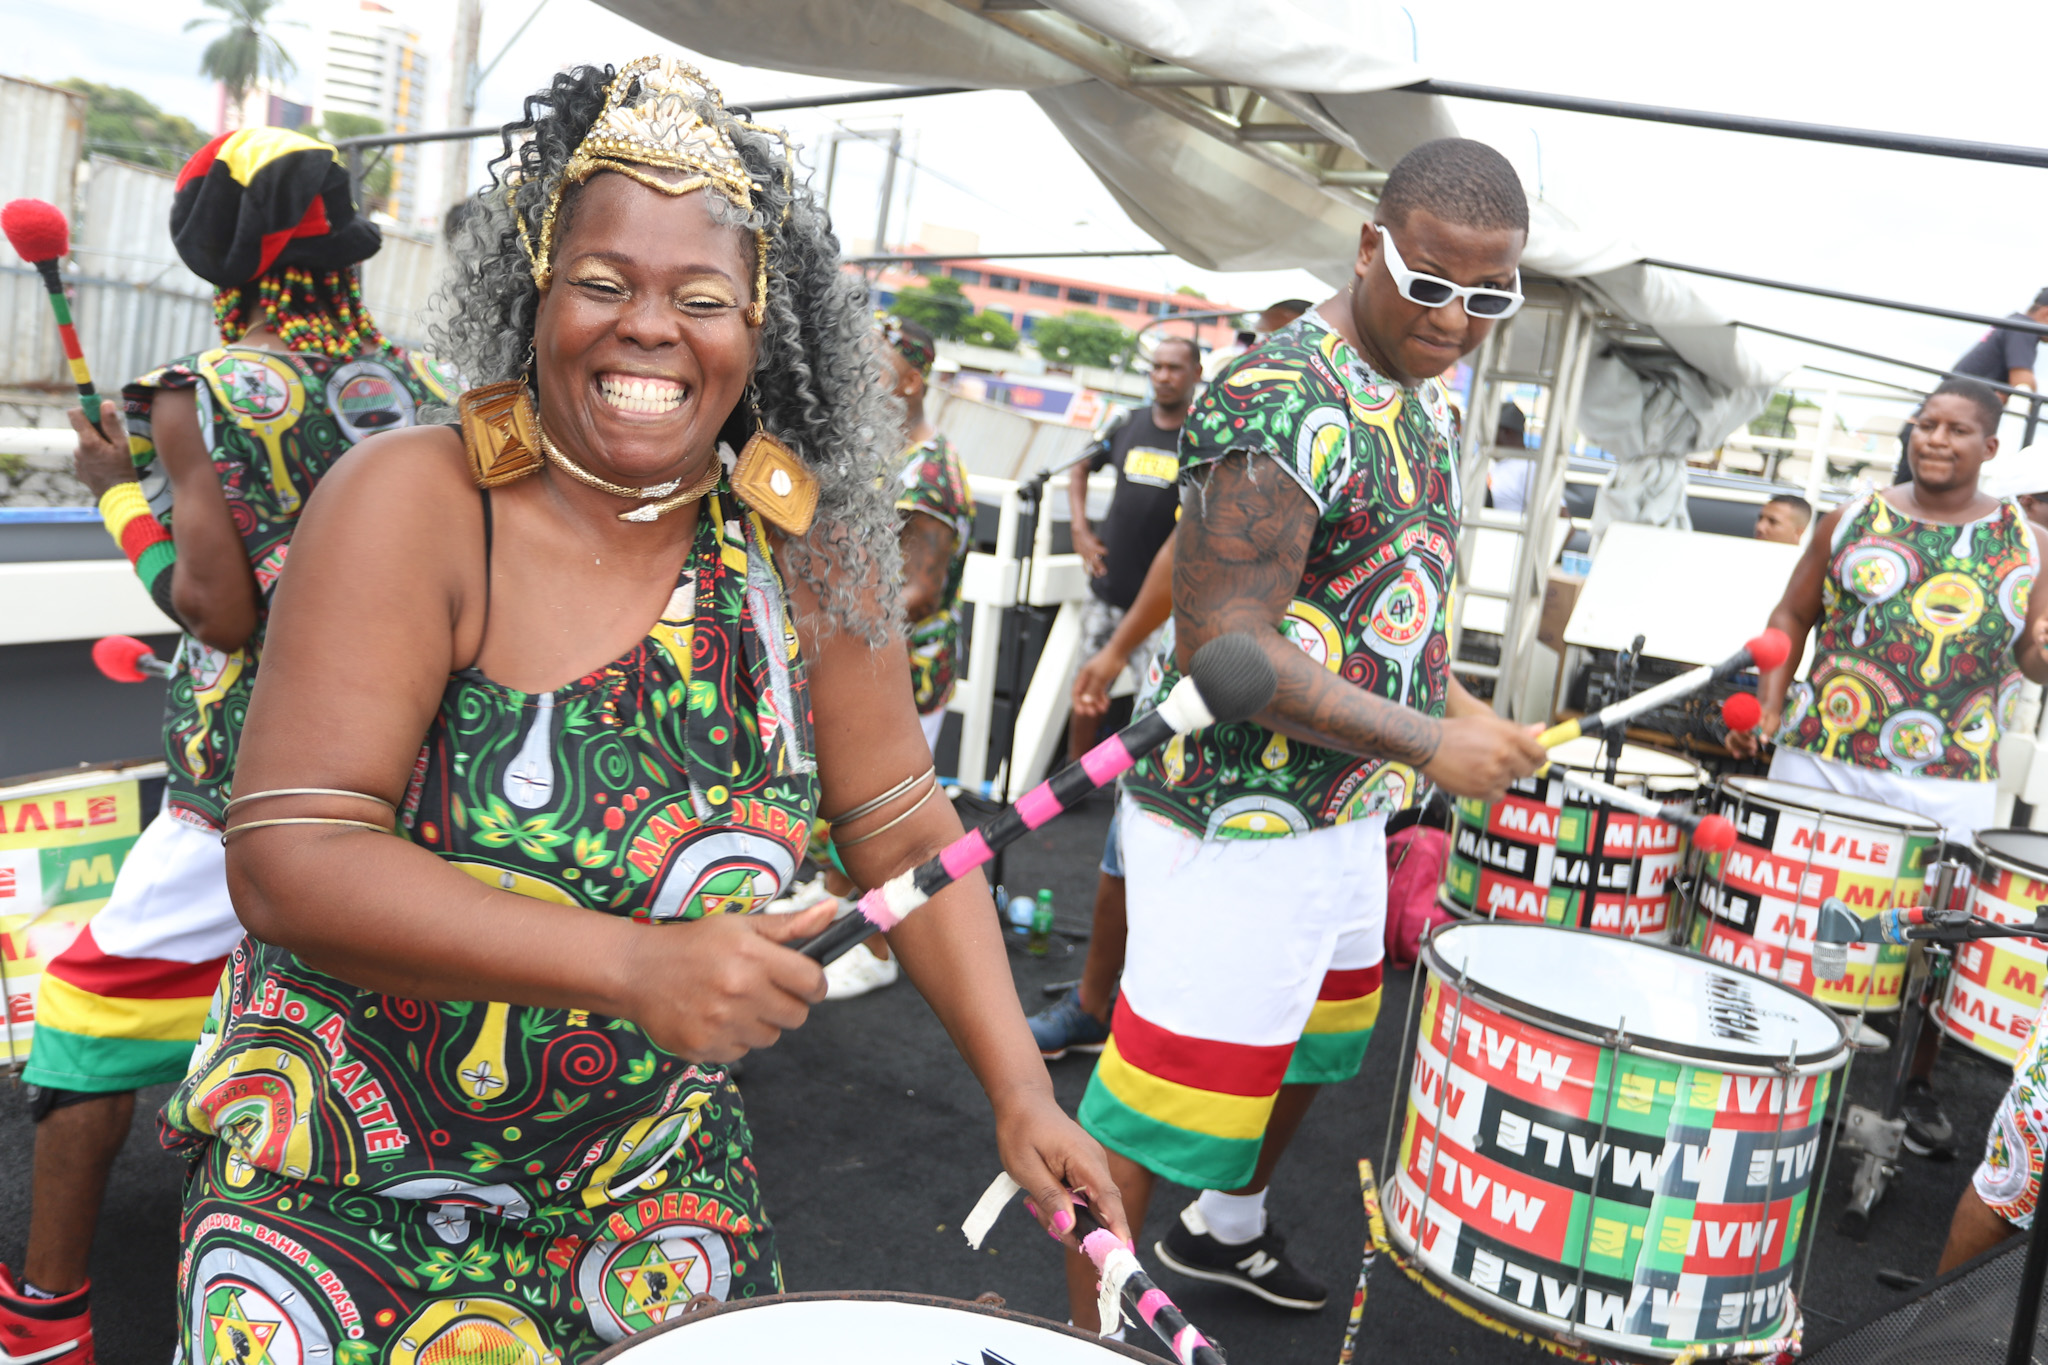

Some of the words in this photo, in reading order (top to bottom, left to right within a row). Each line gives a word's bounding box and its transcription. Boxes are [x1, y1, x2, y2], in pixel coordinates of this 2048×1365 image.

[626, 802, 703, 878] MAL
[194, 1213, 243, 1245] SALVADOR
[254, 1225, 312, 1268] BAHIA
[315, 1266, 360, 1330] BRASIL
